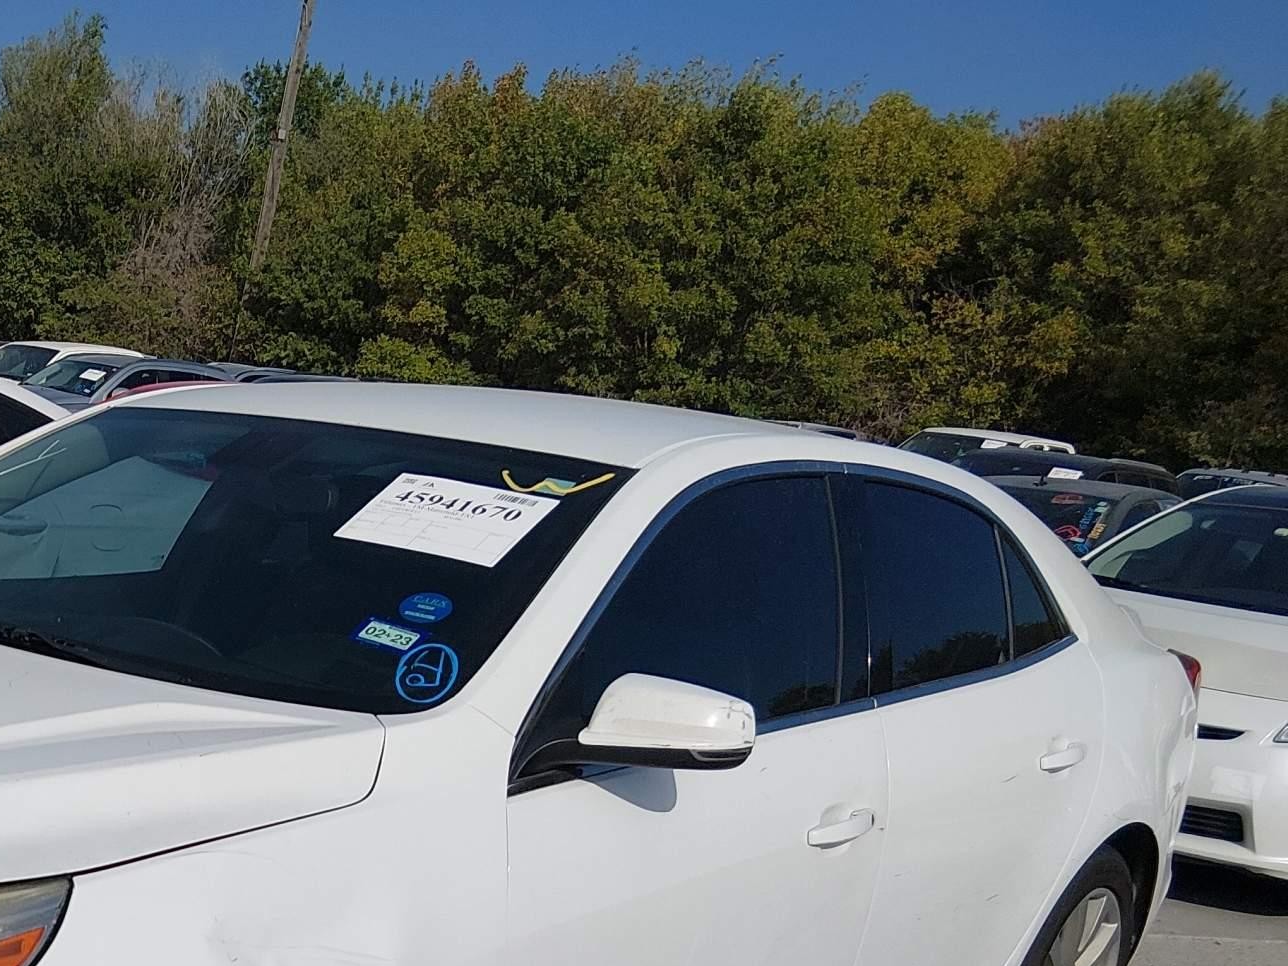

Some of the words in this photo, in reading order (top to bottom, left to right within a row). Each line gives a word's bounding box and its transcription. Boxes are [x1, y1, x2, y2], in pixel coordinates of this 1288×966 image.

[395, 490, 523, 522] 45941670
[365, 626, 387, 639] 02
[390, 633, 413, 646] 23
